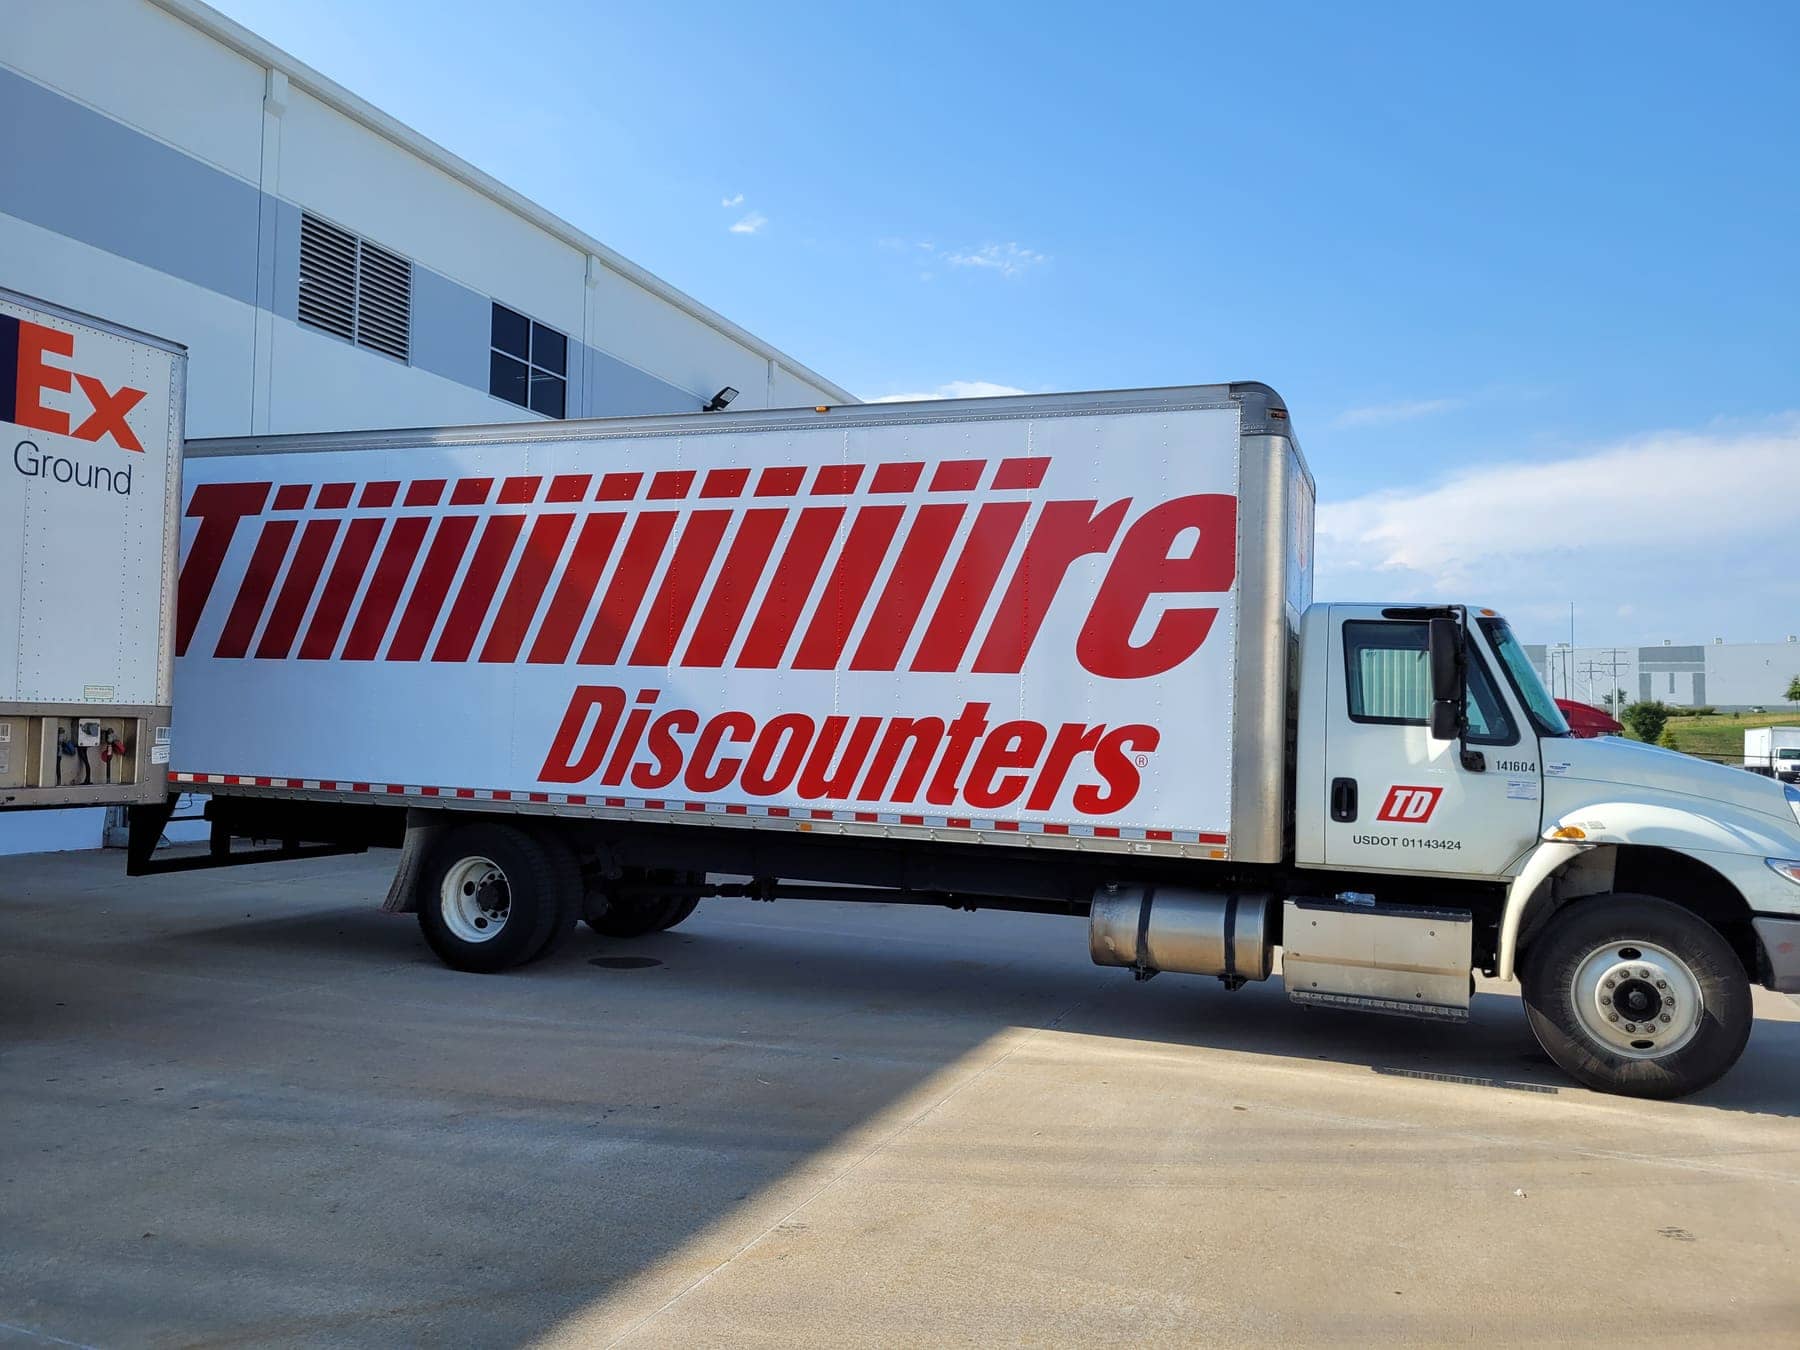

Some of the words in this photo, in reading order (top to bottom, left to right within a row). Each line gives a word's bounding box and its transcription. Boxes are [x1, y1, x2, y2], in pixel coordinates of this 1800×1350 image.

[0, 314, 148, 453] Ex
[13, 440, 132, 496] Ground
[1496, 760, 1536, 773] 141604
[1387, 789, 1434, 819] TD
[1353, 835, 1399, 847] USDOT
[1401, 838, 1462, 851] 01143424
